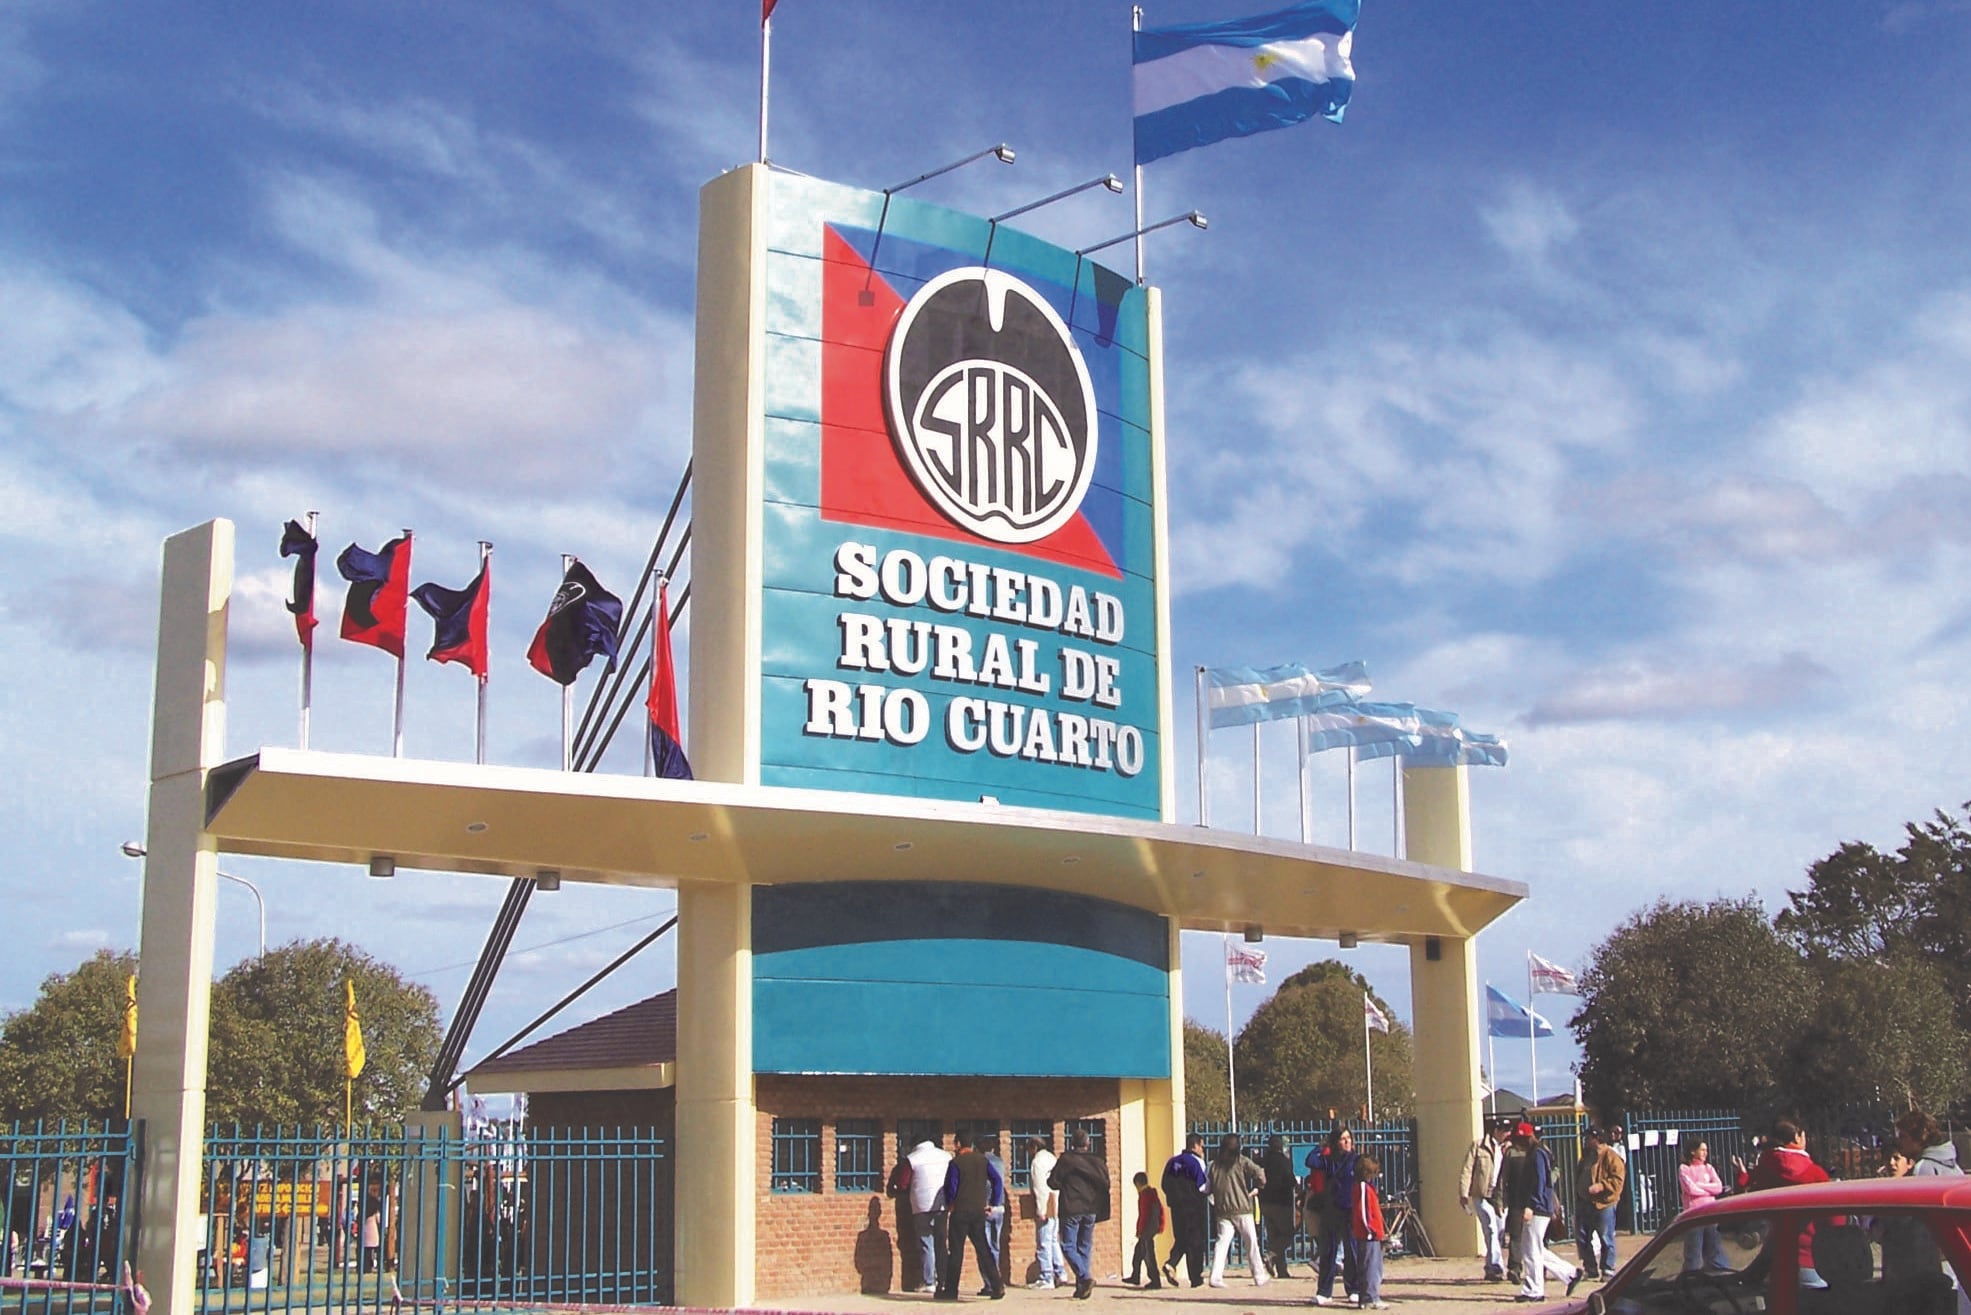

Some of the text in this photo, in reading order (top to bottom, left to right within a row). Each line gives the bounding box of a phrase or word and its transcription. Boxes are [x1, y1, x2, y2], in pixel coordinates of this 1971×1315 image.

[920, 367, 1067, 516] SRRC
[836, 541, 1125, 643] SOCIEDAD
[839, 612, 1121, 706] RURAL DE
[806, 678, 1144, 775] RIO CUARTO
